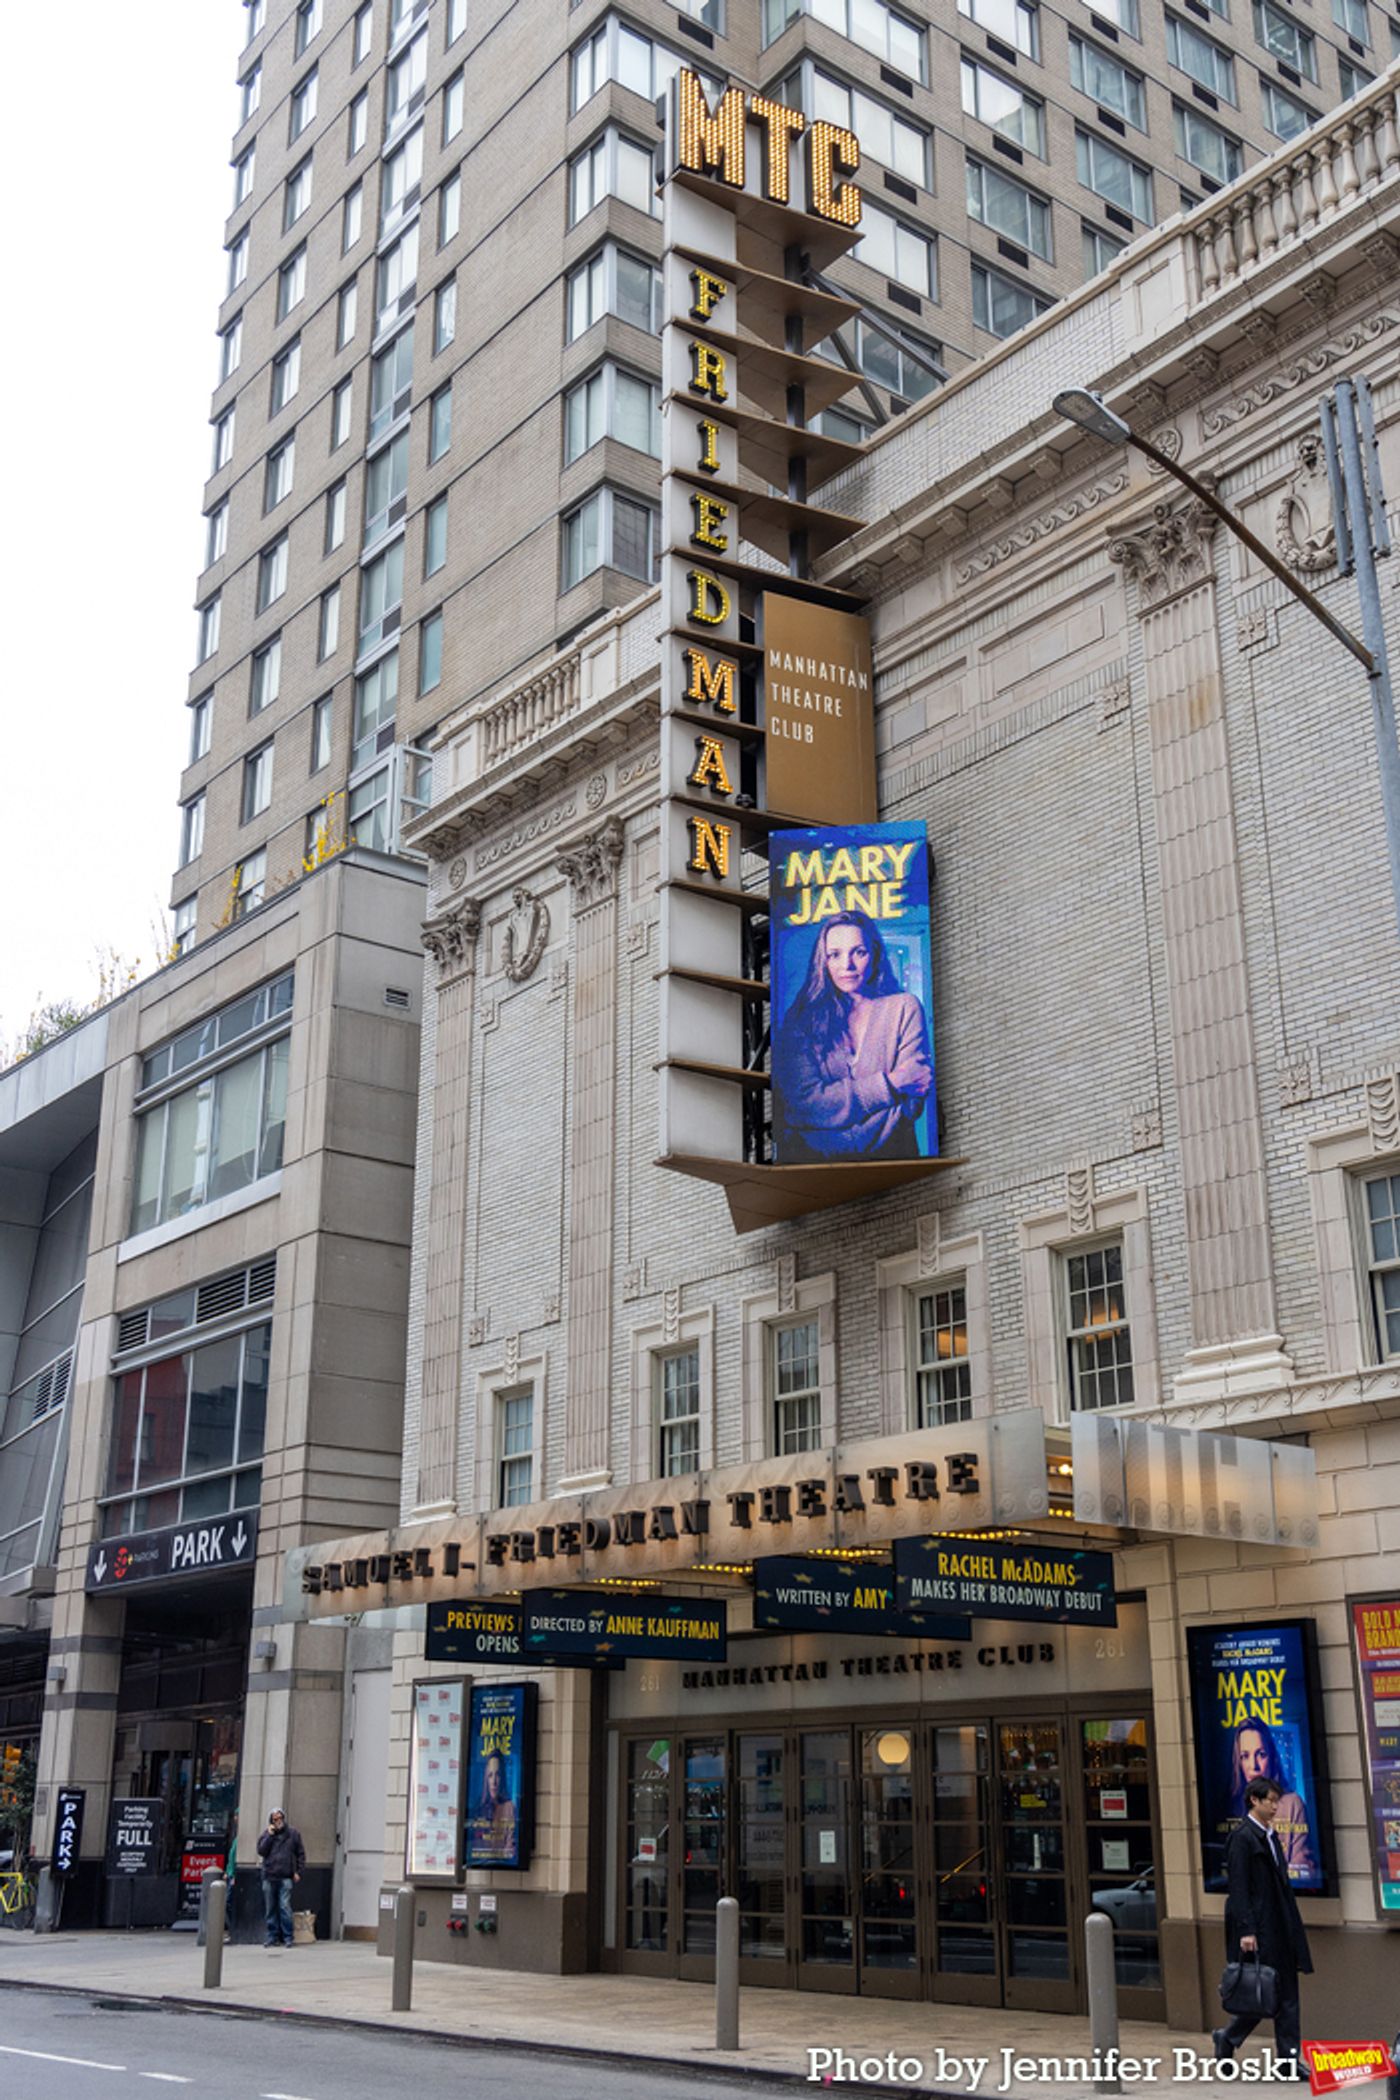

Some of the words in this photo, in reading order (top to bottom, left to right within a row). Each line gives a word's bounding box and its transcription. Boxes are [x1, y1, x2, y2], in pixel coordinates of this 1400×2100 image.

[677, 66, 861, 228] MTC
[682, 266, 738, 880] FRIEDMAN
[769, 649, 868, 691] MANHATTAN
[770, 682, 843, 718] THEATRE
[771, 716, 814, 744] CLUB
[785, 842, 914, 888] MARY
[788, 881, 904, 926] JANE
[302, 1547, 434, 1595] SAMUEL
[485, 1500, 711, 1567] FRIEDMAN
[727, 1452, 979, 1529] THEATRE
[171, 1525, 225, 1570] PARK
[938, 1551, 997, 1580] RACHEL
[1002, 1557, 1077, 1586] McADAMS
[776, 1587, 832, 1607] WRITTEN
[834, 1592, 850, 1607] BY
[853, 1587, 888, 1610] AMY
[911, 1578, 957, 1600] MAKES
[960, 1582, 986, 1602] HER
[990, 1585, 1061, 1608] BROADWAY
[1064, 1590, 1102, 1612] DEBUT
[447, 1611, 515, 1633] PREVIEWS
[530, 1616, 586, 1632] DIRECTED
[588, 1619, 604, 1634] BY
[606, 1615, 644, 1636] ANNE
[647, 1618, 719, 1640] KAUFFMAN
[475, 1634, 520, 1654] OPENS
[683, 1661, 829, 1689] MANHATTAN
[840, 1649, 963, 1678] THEATRE
[977, 1643, 1056, 1668] CLUB
[1217, 1668, 1288, 1700] MARY
[481, 1715, 516, 1736] MARY
[1220, 1698, 1284, 1728] JANE
[59, 1802, 78, 1857] PARK
[116, 1830, 153, 1846] FULL
